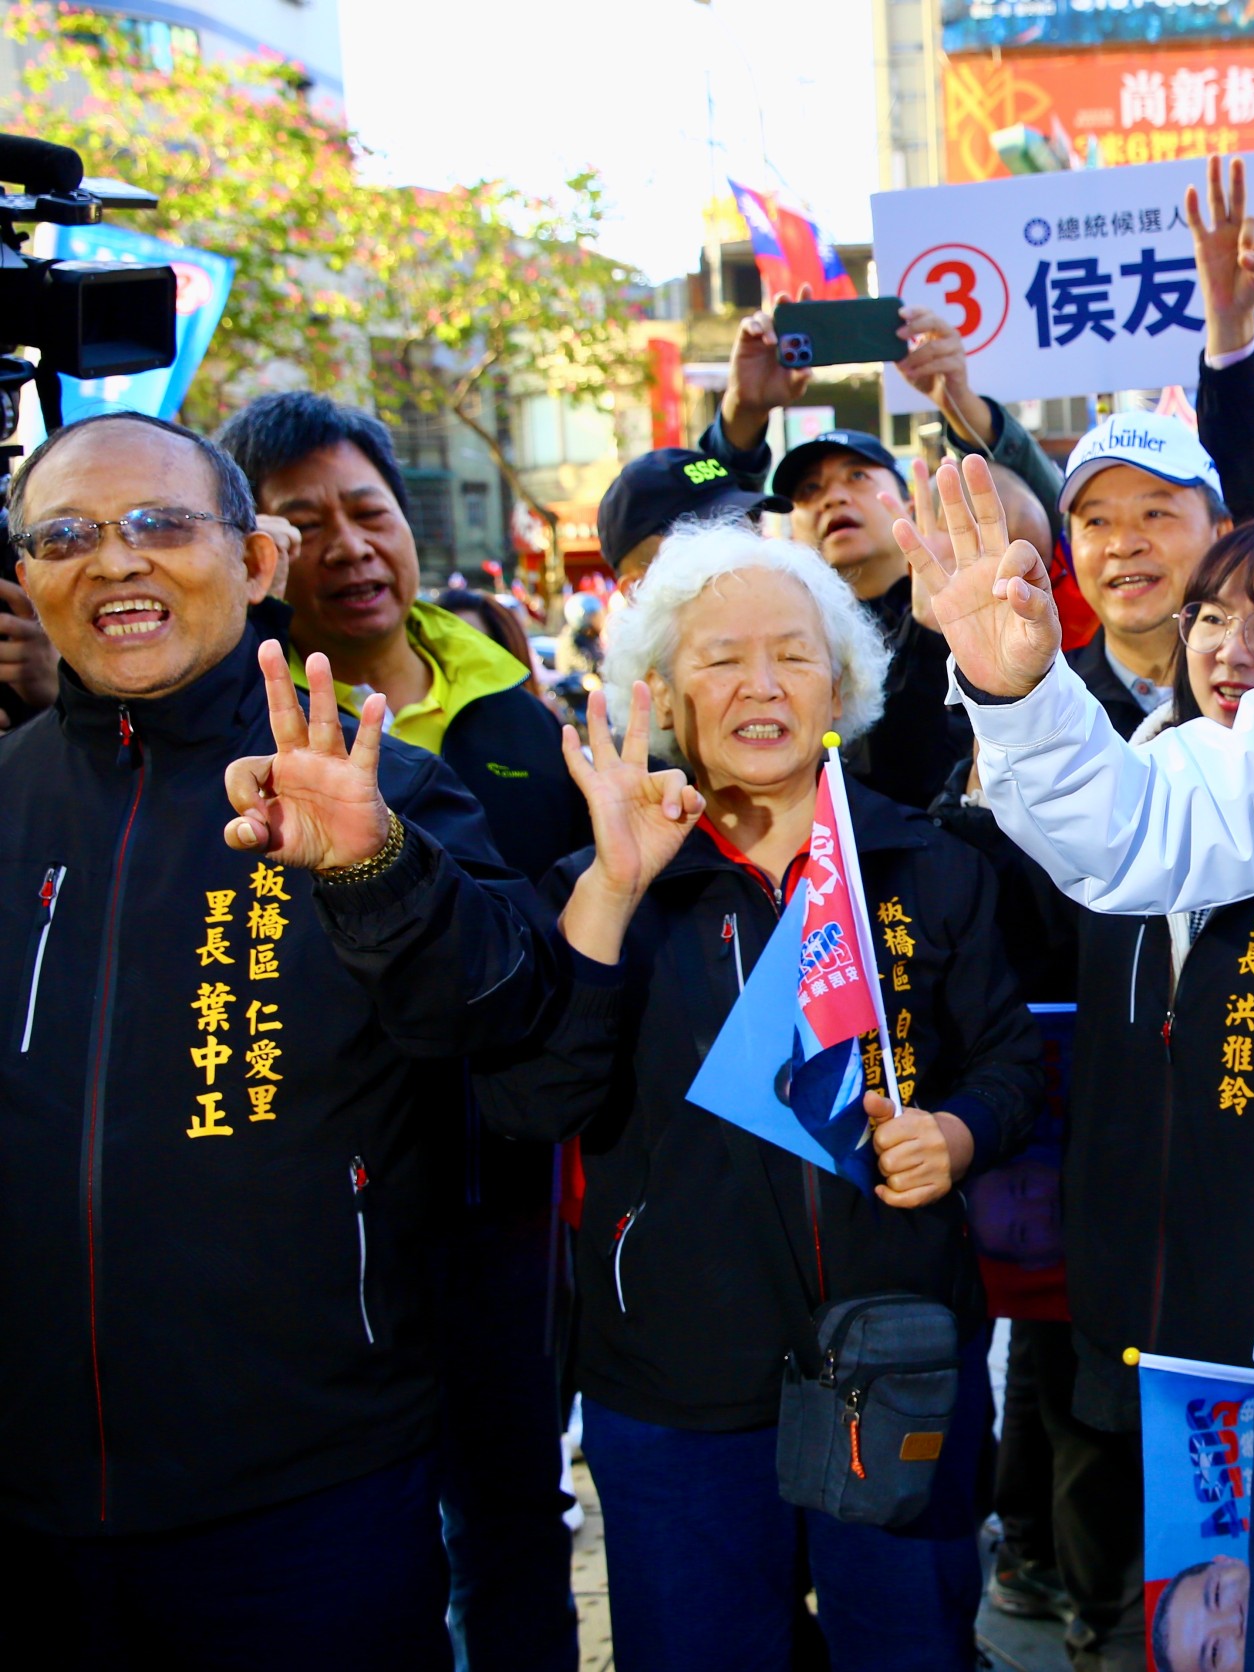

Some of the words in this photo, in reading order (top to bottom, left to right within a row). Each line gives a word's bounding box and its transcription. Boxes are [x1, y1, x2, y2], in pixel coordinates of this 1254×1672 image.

[1056, 206, 1192, 242] 總統候選人
[924, 260, 982, 338] 3
[683, 458, 728, 485] SSC
[1109, 420, 1166, 453] bühler
[195, 889, 237, 967] 里長
[246, 862, 292, 981] 板橋區
[877, 896, 917, 993] 板橋區
[186, 982, 237, 1139] 葉中正
[245, 999, 284, 1123] 仁愛里
